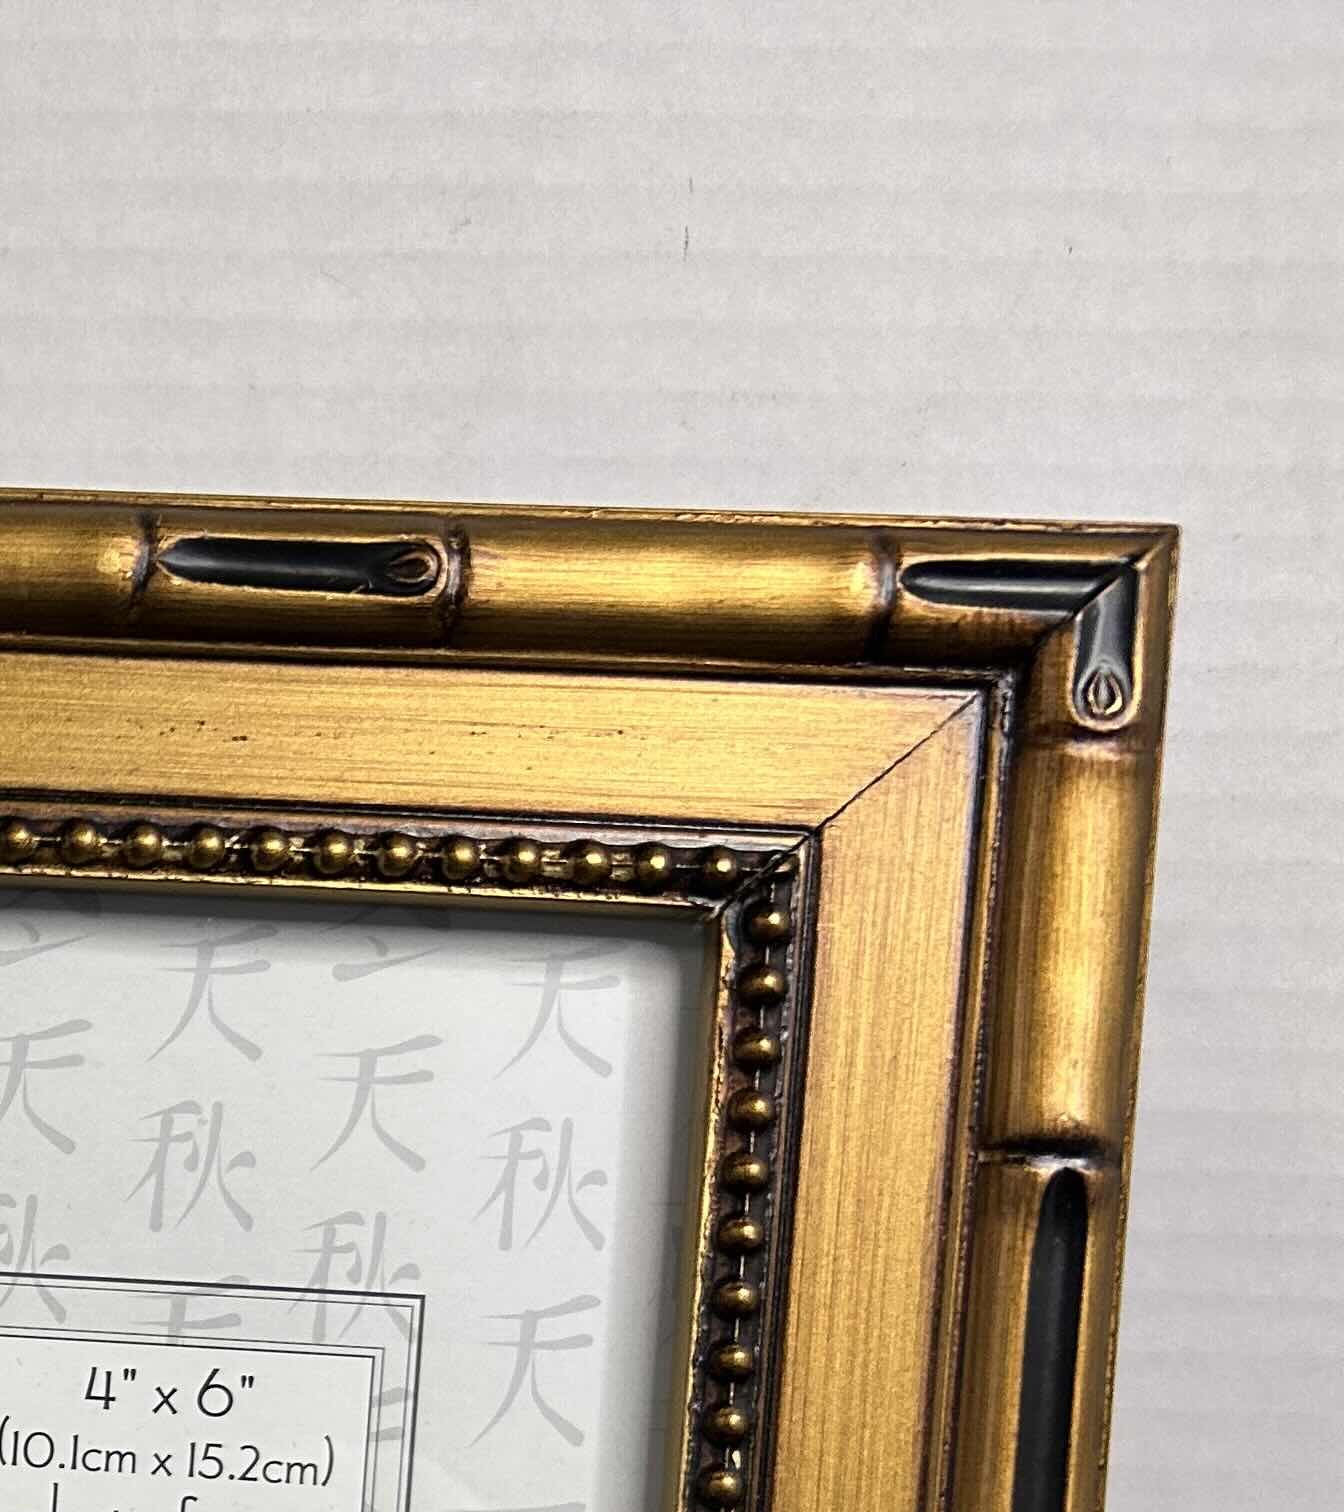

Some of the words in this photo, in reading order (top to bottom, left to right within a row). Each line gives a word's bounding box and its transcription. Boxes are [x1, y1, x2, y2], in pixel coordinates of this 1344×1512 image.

[84, 1366, 137, 1410] 4"
[151, 1385, 179, 1416] x
[196, 1368, 255, 1418] 6"
[150, 1451, 174, 1477] x
[187, 1434, 335, 1487] 15.2cm)
